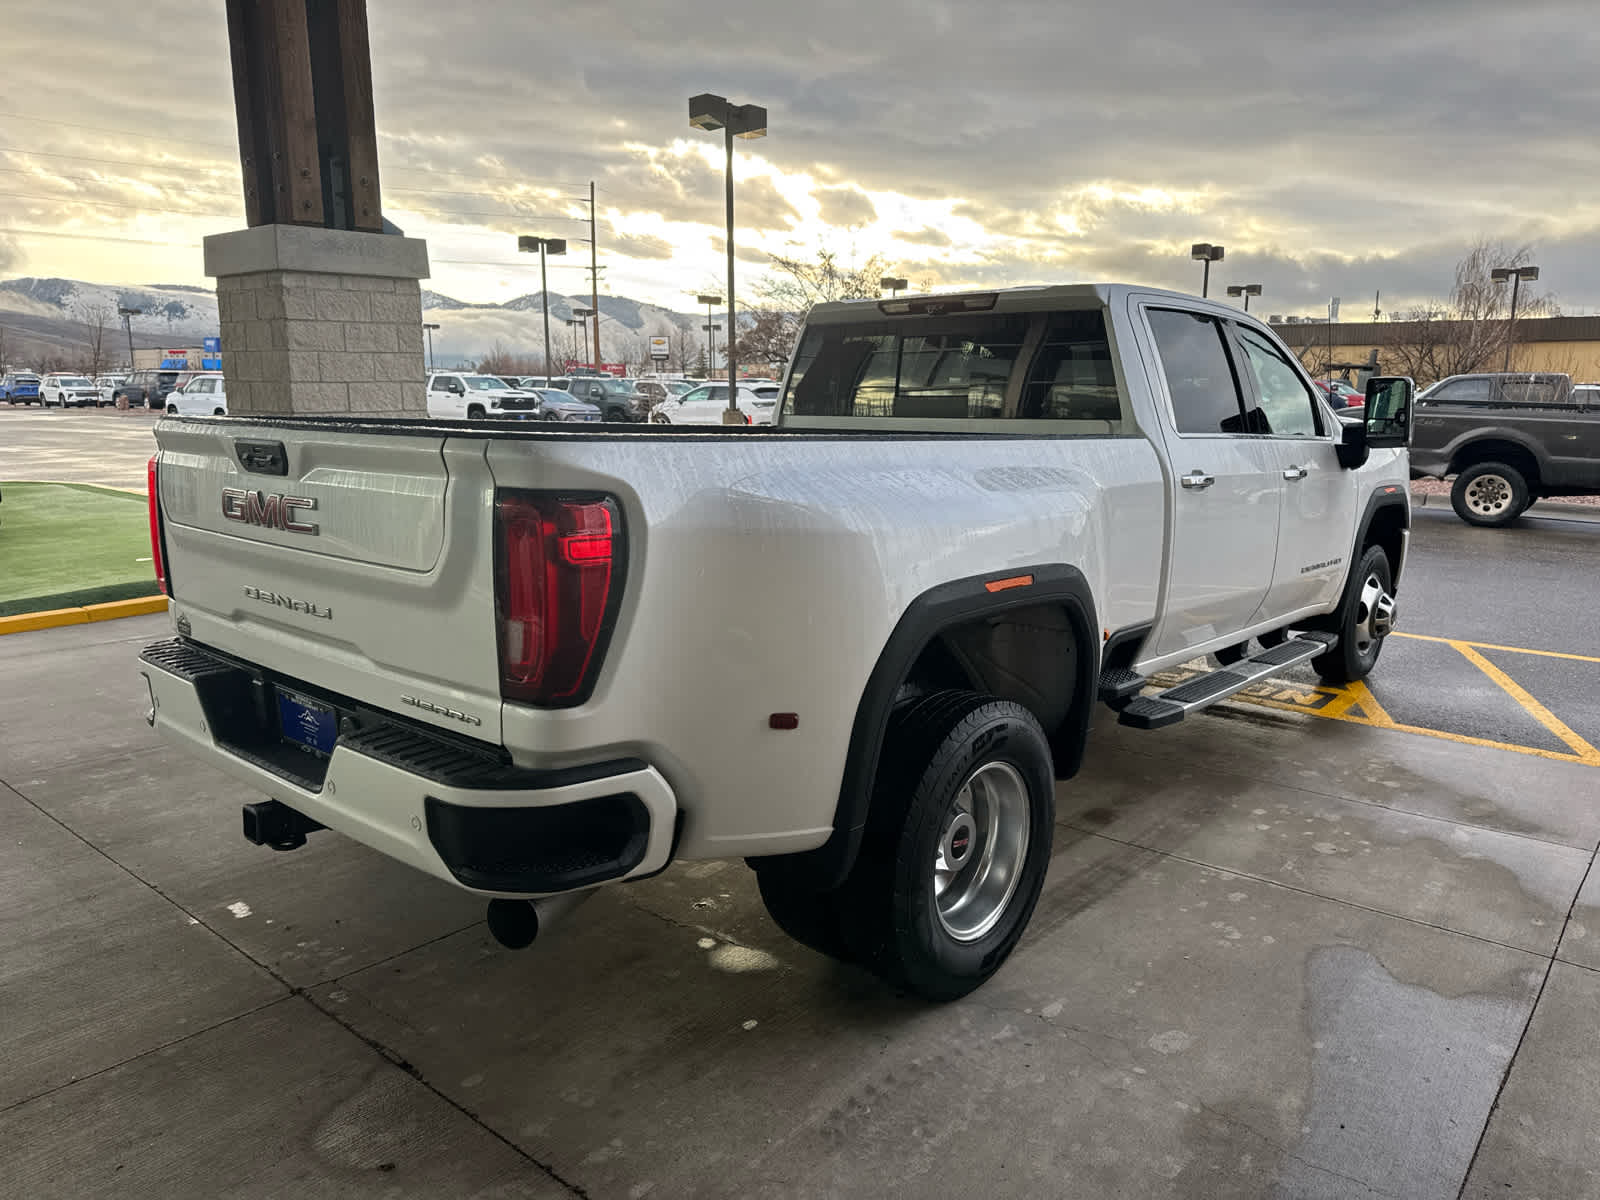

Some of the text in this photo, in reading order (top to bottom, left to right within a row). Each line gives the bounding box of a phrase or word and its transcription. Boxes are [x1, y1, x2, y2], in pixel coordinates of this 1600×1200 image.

[222, 488, 319, 536] GMC
[241, 585, 333, 620] DENALI
[400, 694, 482, 726] SIERRA
